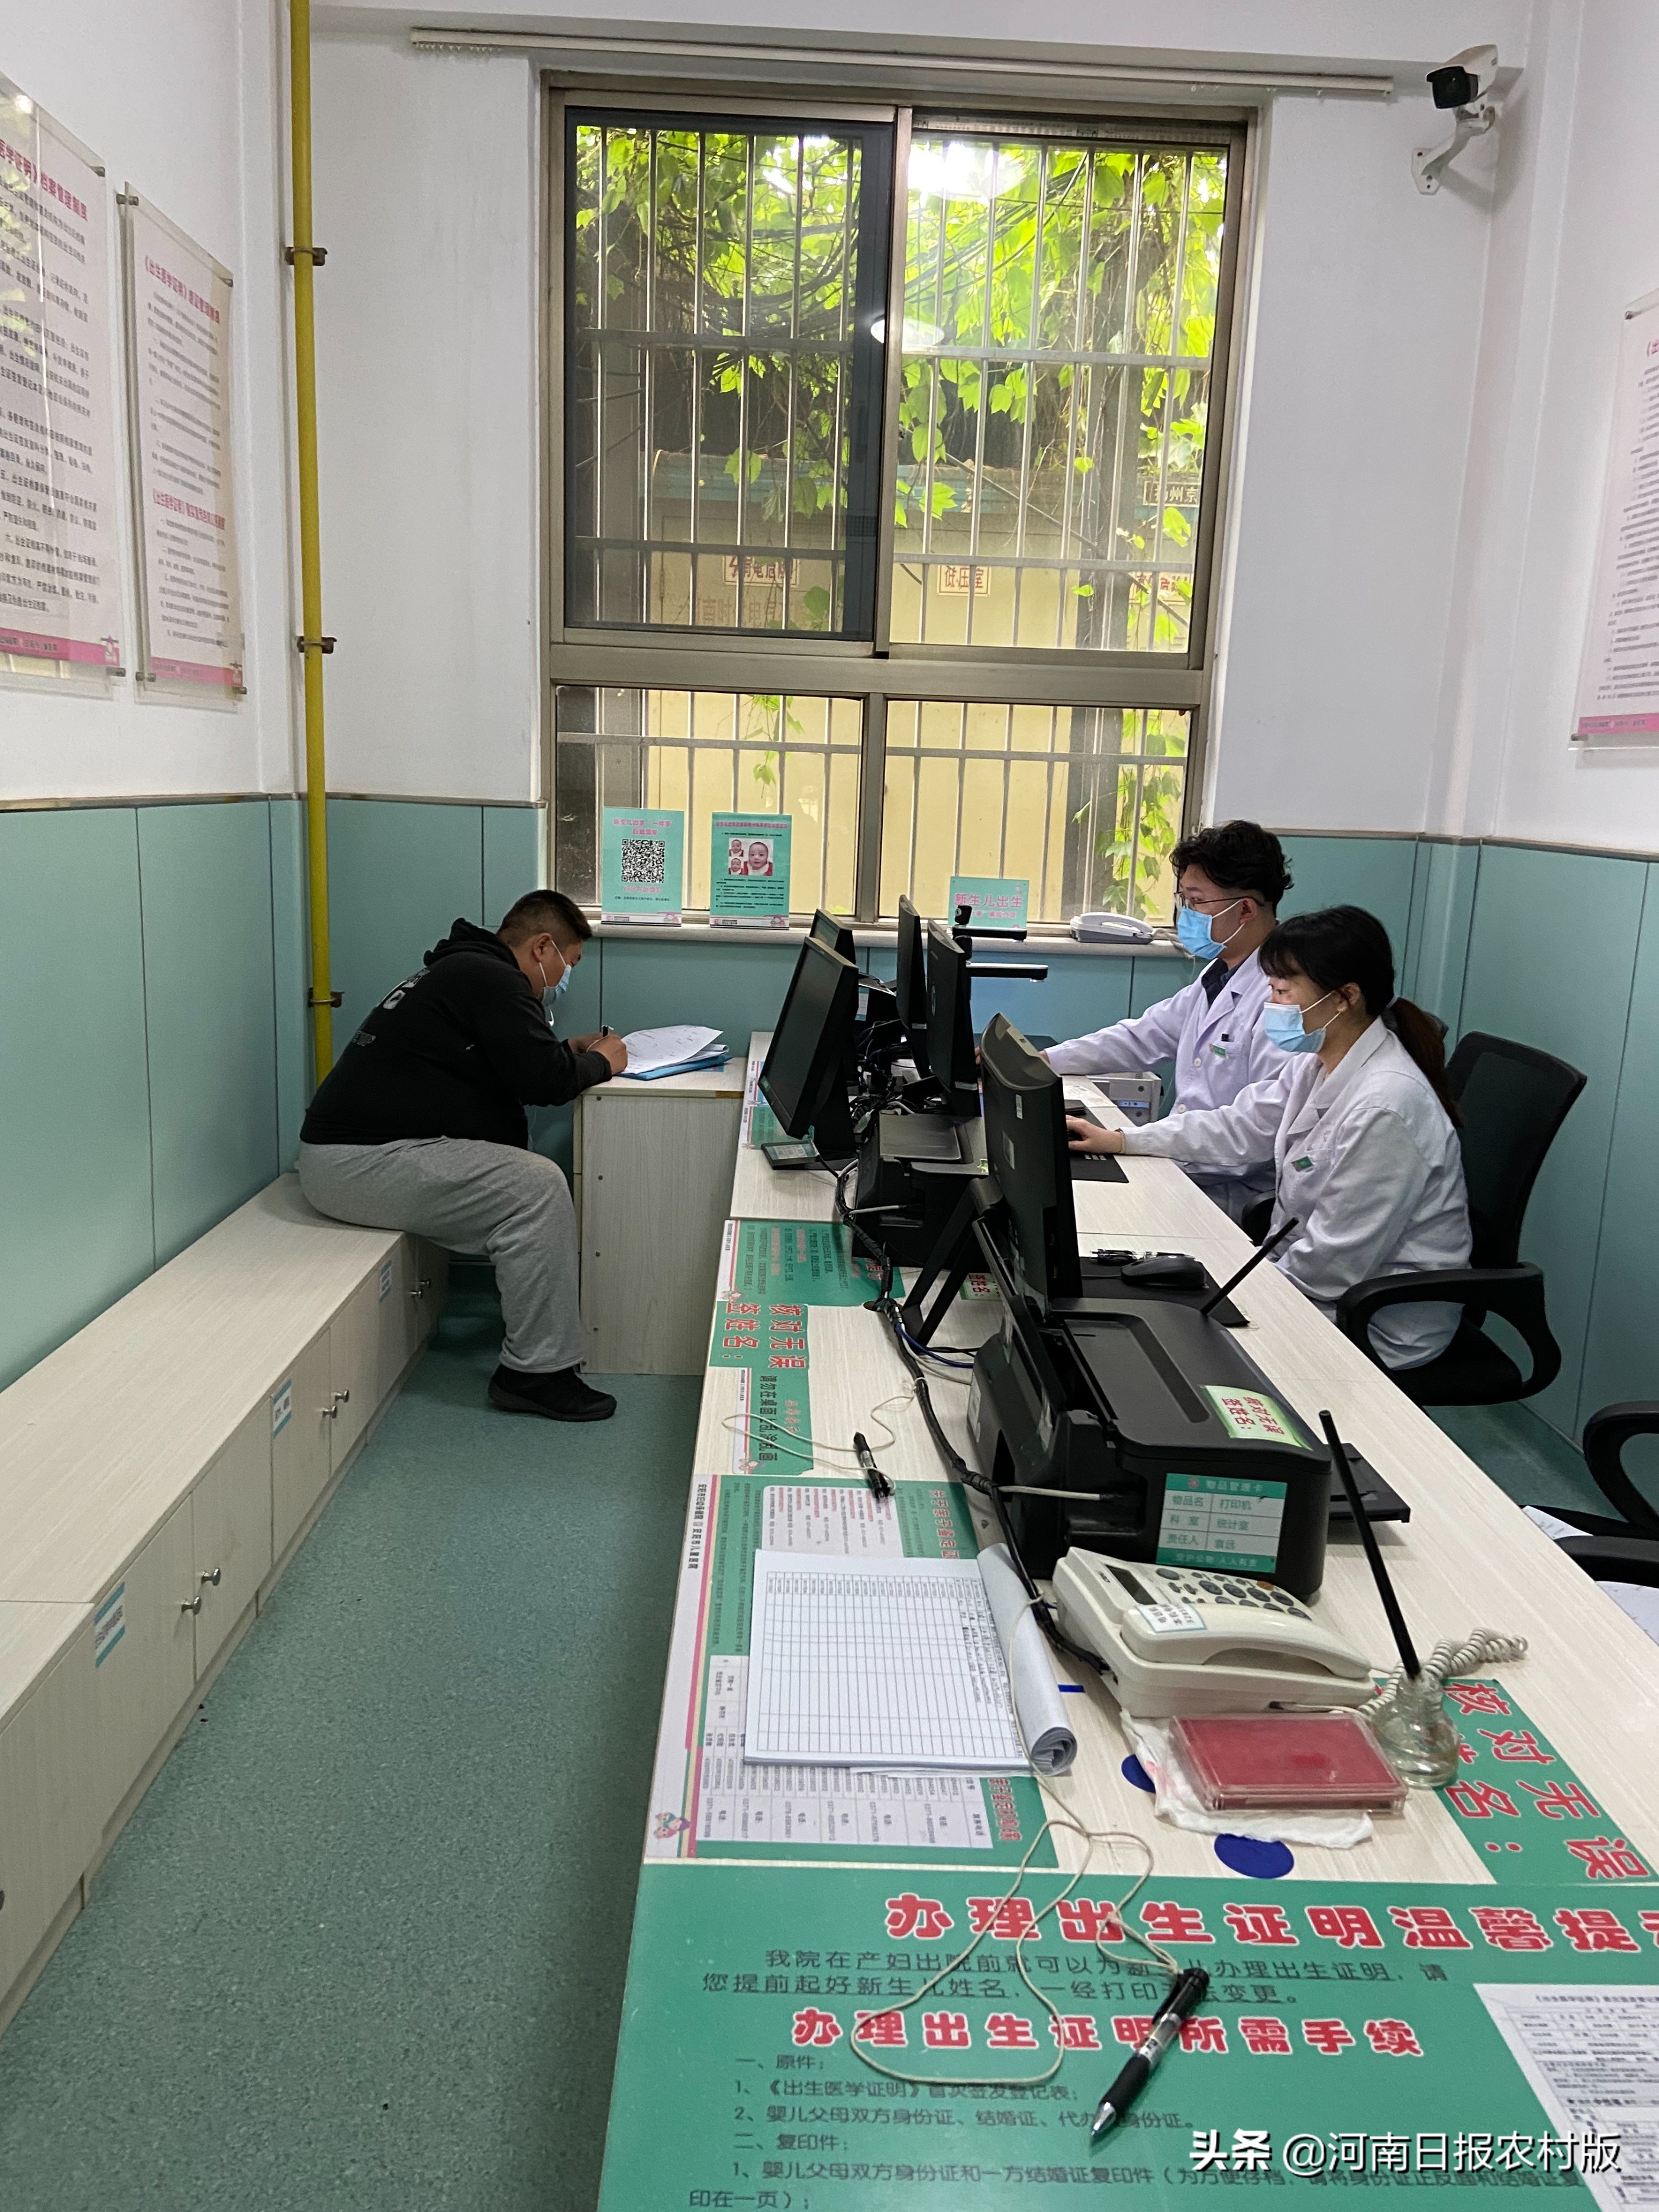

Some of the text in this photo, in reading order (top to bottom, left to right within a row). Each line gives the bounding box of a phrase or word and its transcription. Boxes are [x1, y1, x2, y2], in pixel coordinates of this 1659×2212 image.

[955, 893, 1023, 908] 新生儿出生
[722, 1302, 761, 1359] 签姓名：
[769, 1304, 806, 1368] 核对无误
[1243, 1397, 1284, 1434] 核对无误
[1219, 1498, 1252, 1511] 打印机
[1443, 1682, 1650, 1879] 核对无误
[792, 2007, 1424, 2057] 办理出生证明所需手续
[734, 2106, 1194, 2129] 2、婴儿父母双方身份证、结婚证、代办身份证。
